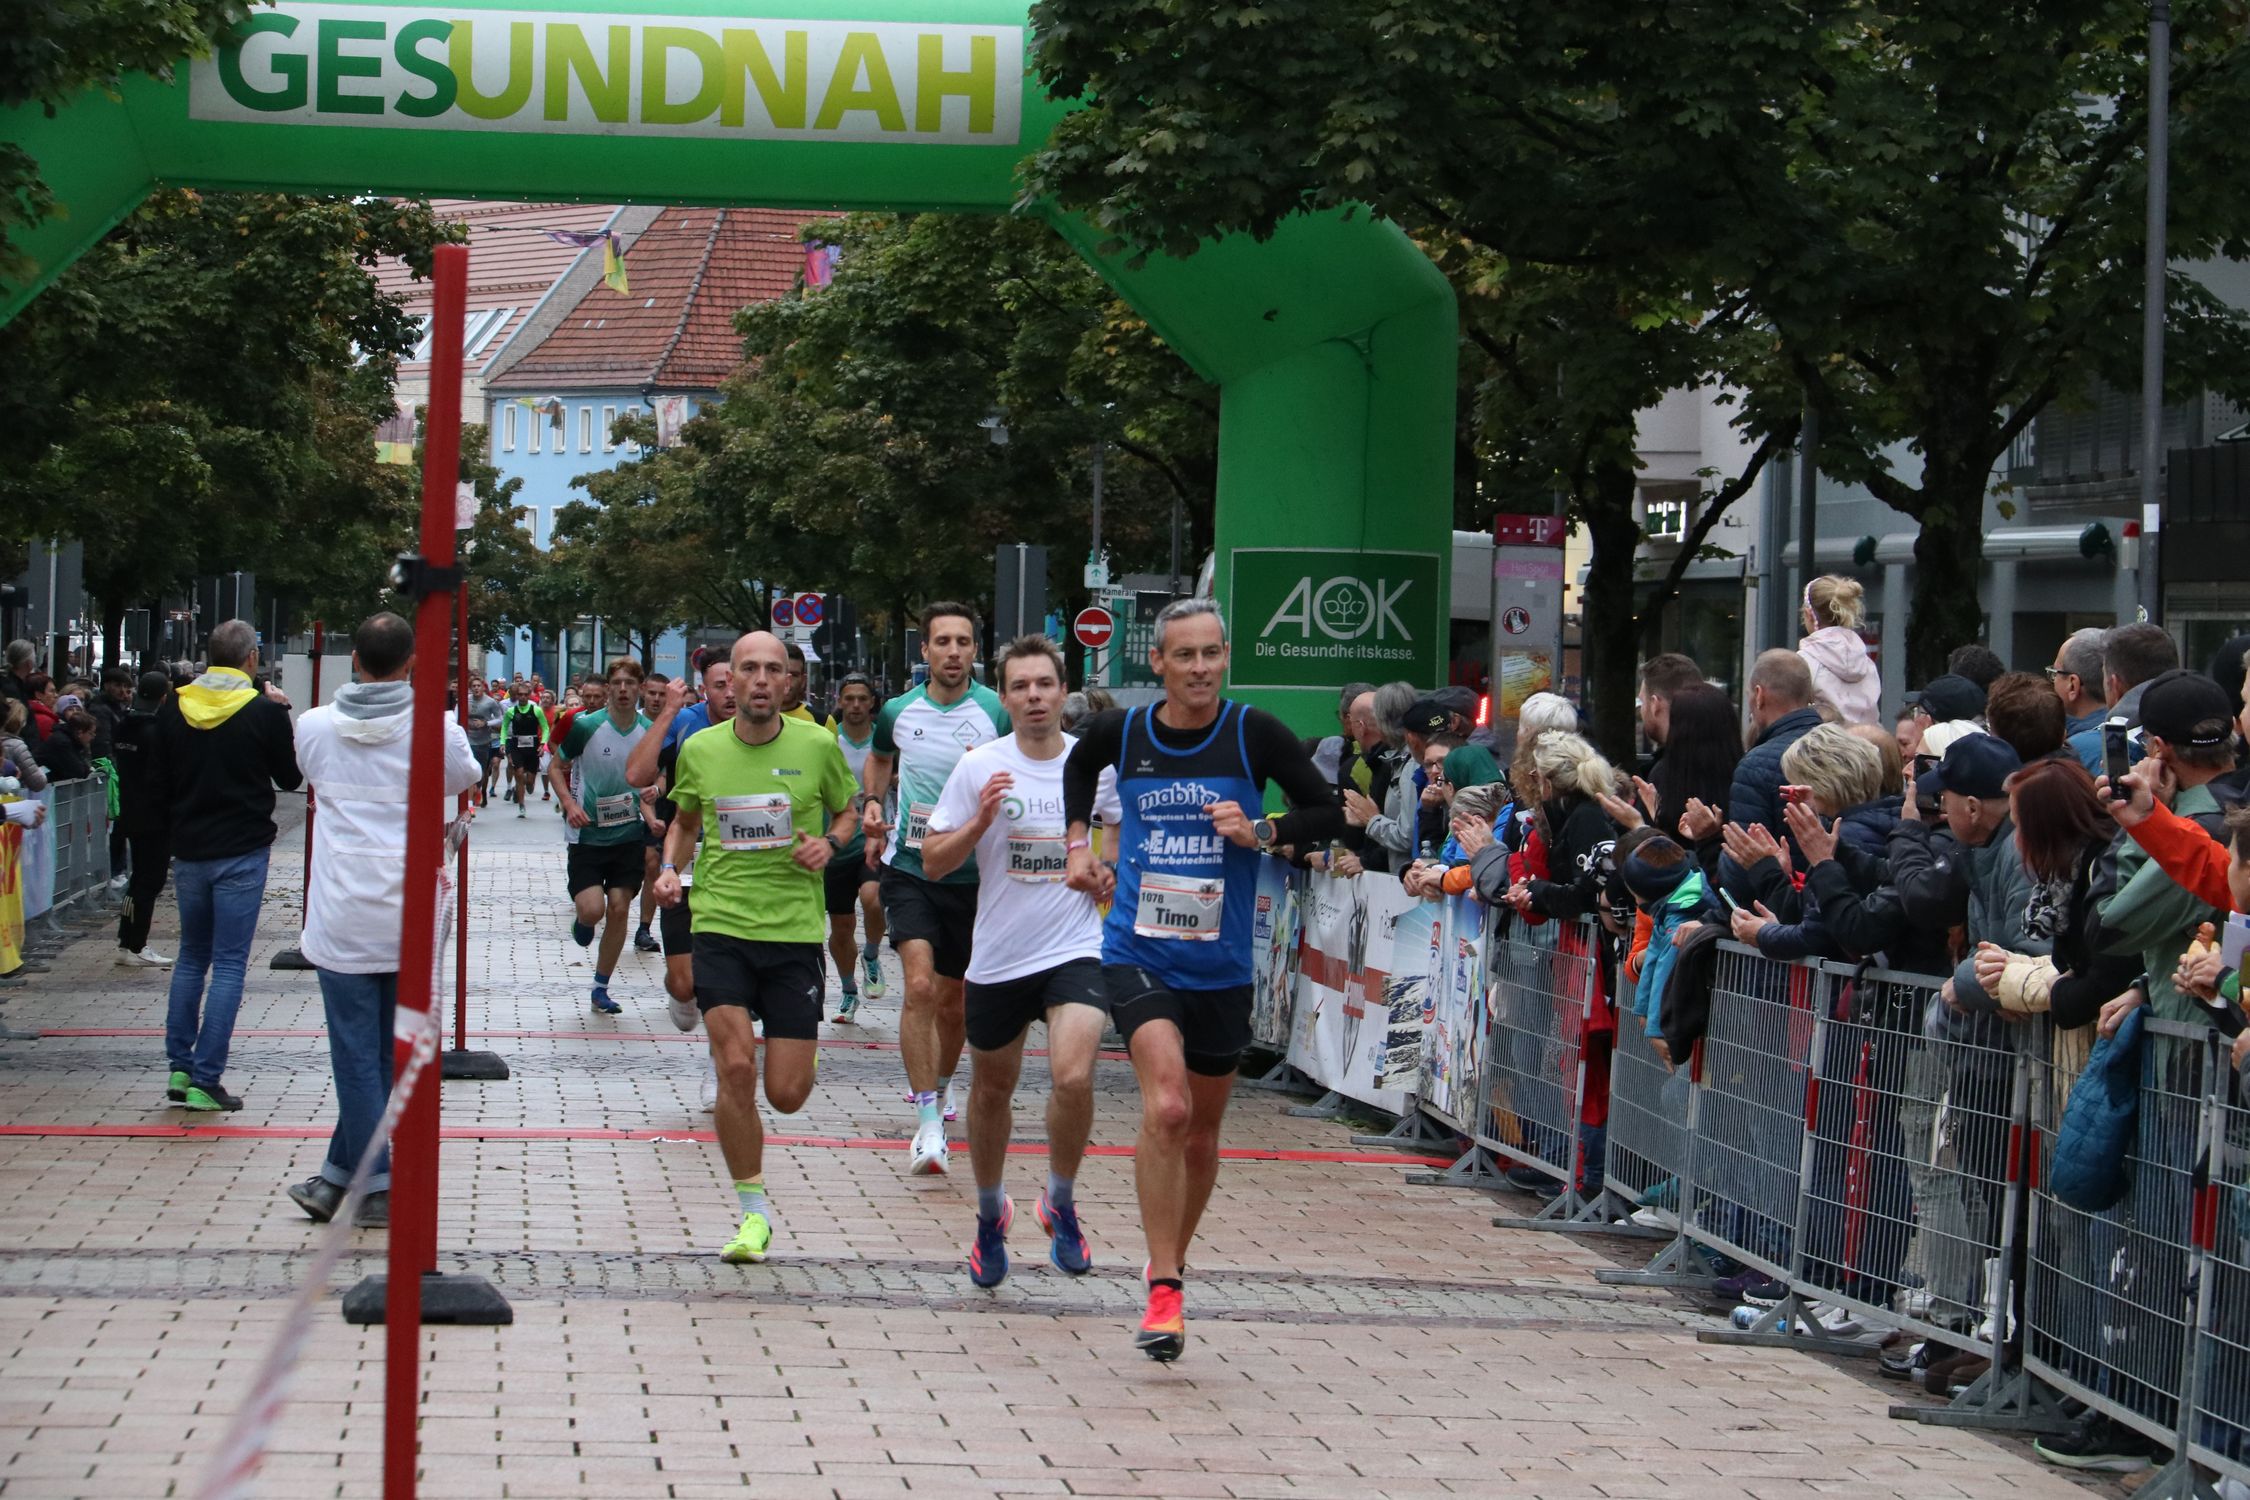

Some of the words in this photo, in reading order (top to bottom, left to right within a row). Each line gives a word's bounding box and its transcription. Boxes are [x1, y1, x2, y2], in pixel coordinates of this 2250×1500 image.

[217, 13, 996, 134] GESUNDNAH
[1102, 588, 1137, 597] Kamerala
[1260, 576, 1413, 641] AOK
[1255, 642, 1276, 657] Die
[1280, 643, 1416, 660] Gesundheitskasse.
[1138, 782, 1221, 812] mabitz
[604, 808, 631, 821] Henrik
[719, 814, 729, 823] 47
[731, 823, 776, 839] Frank
[911, 826, 926, 840] Mi
[1149, 830, 1224, 854] EMELE
[1012, 854, 1068, 873] Raphae
[1142, 892, 1164, 904] 1078
[1155, 907, 1199, 929] Timo
